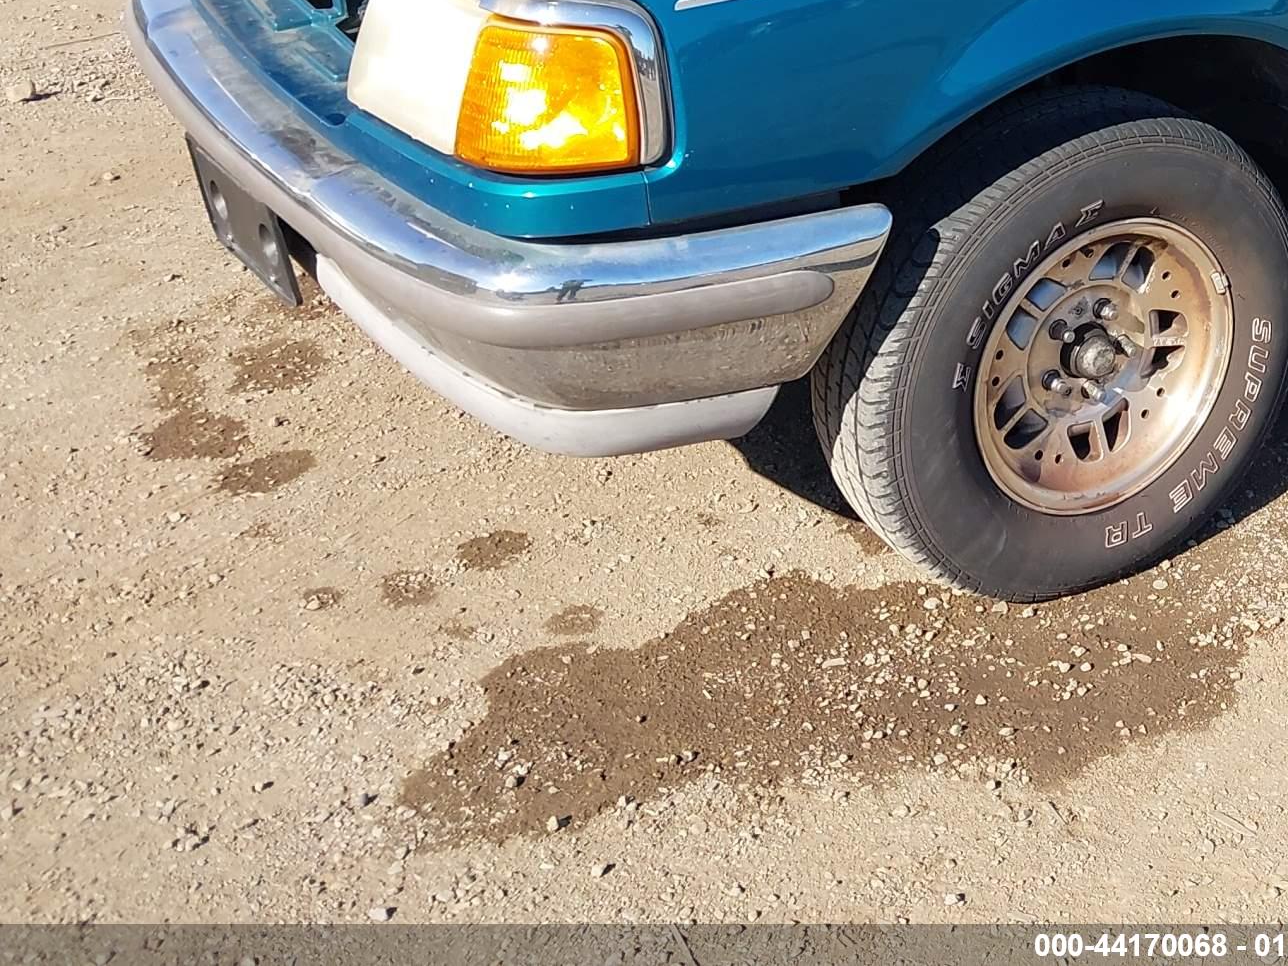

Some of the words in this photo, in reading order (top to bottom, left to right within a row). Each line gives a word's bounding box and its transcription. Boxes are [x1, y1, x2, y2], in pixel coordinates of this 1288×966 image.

[966, 220, 1066, 350] SIGMA
[1168, 317, 1272, 514] SUPREME
[1104, 511, 1154, 549] TR
